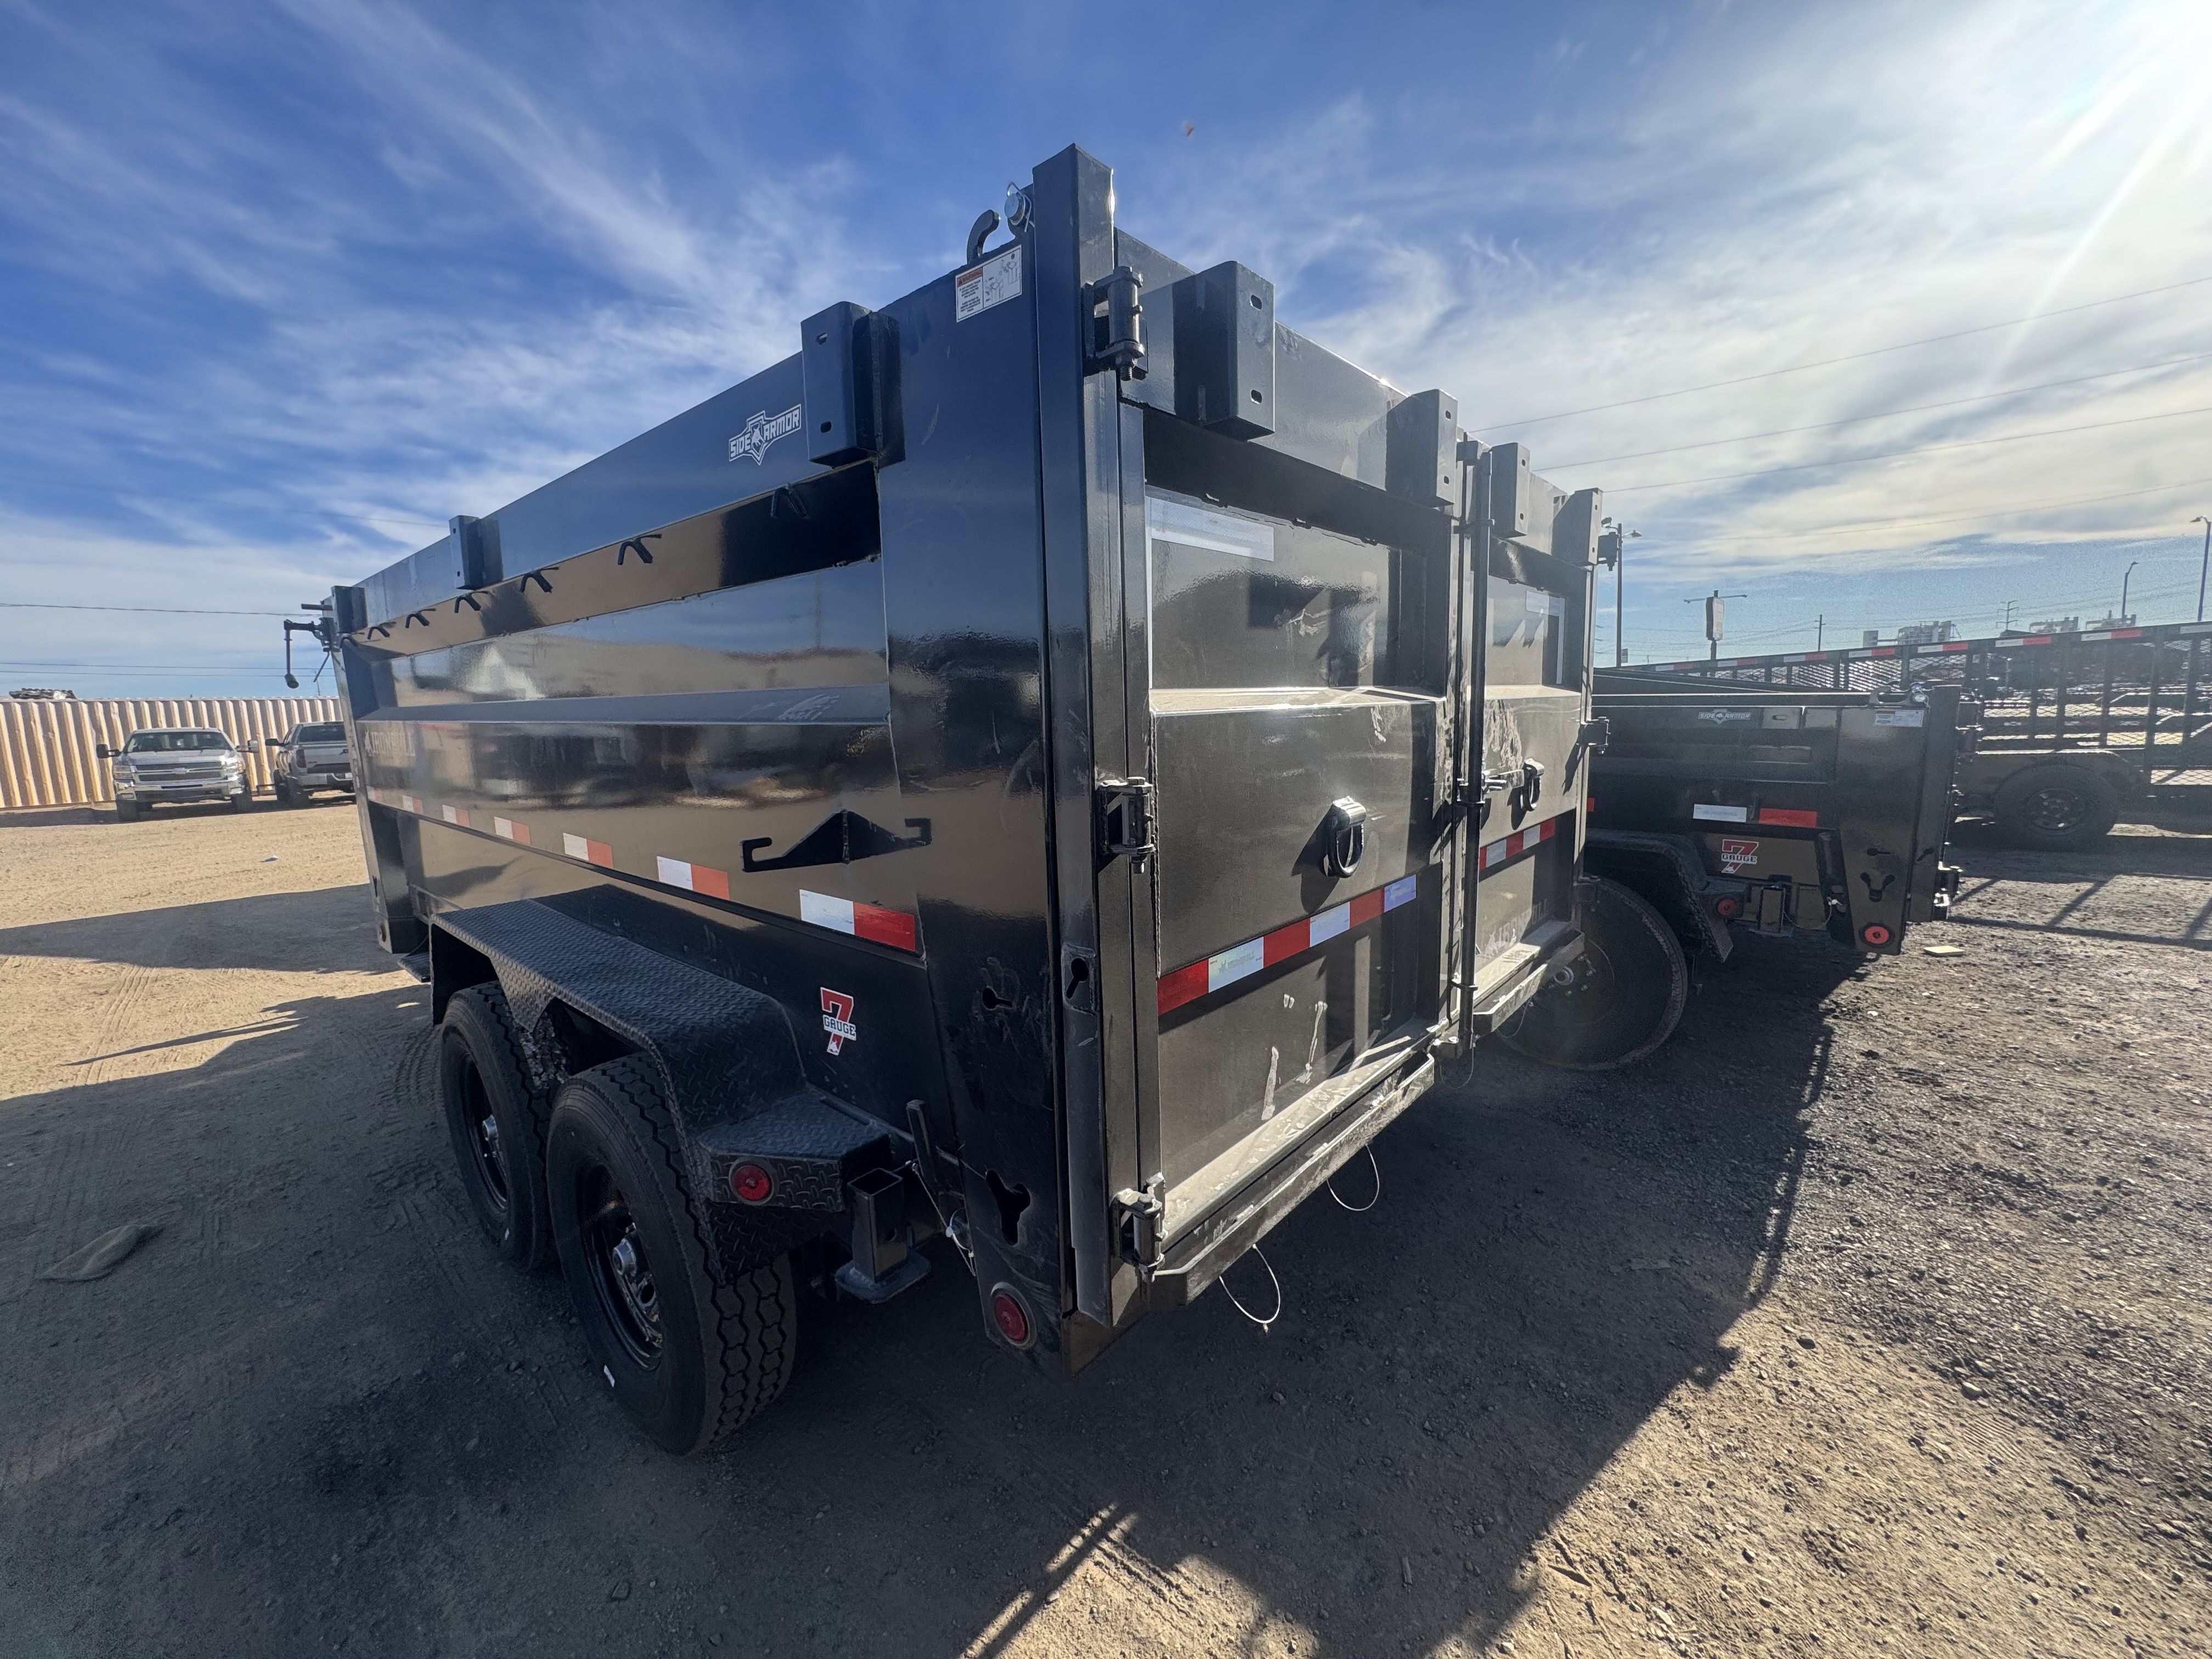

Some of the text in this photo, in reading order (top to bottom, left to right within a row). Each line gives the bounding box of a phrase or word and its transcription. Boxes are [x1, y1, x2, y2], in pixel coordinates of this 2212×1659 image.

[962, 269, 982, 283] WARNING
[730, 409, 800, 458] SIDE ARMOR
[1722, 839, 1759, 874] 7
[1722, 854, 1757, 862] GAUGE
[820, 987, 854, 1056] 7
[824, 1016, 856, 1036] GAUGE
